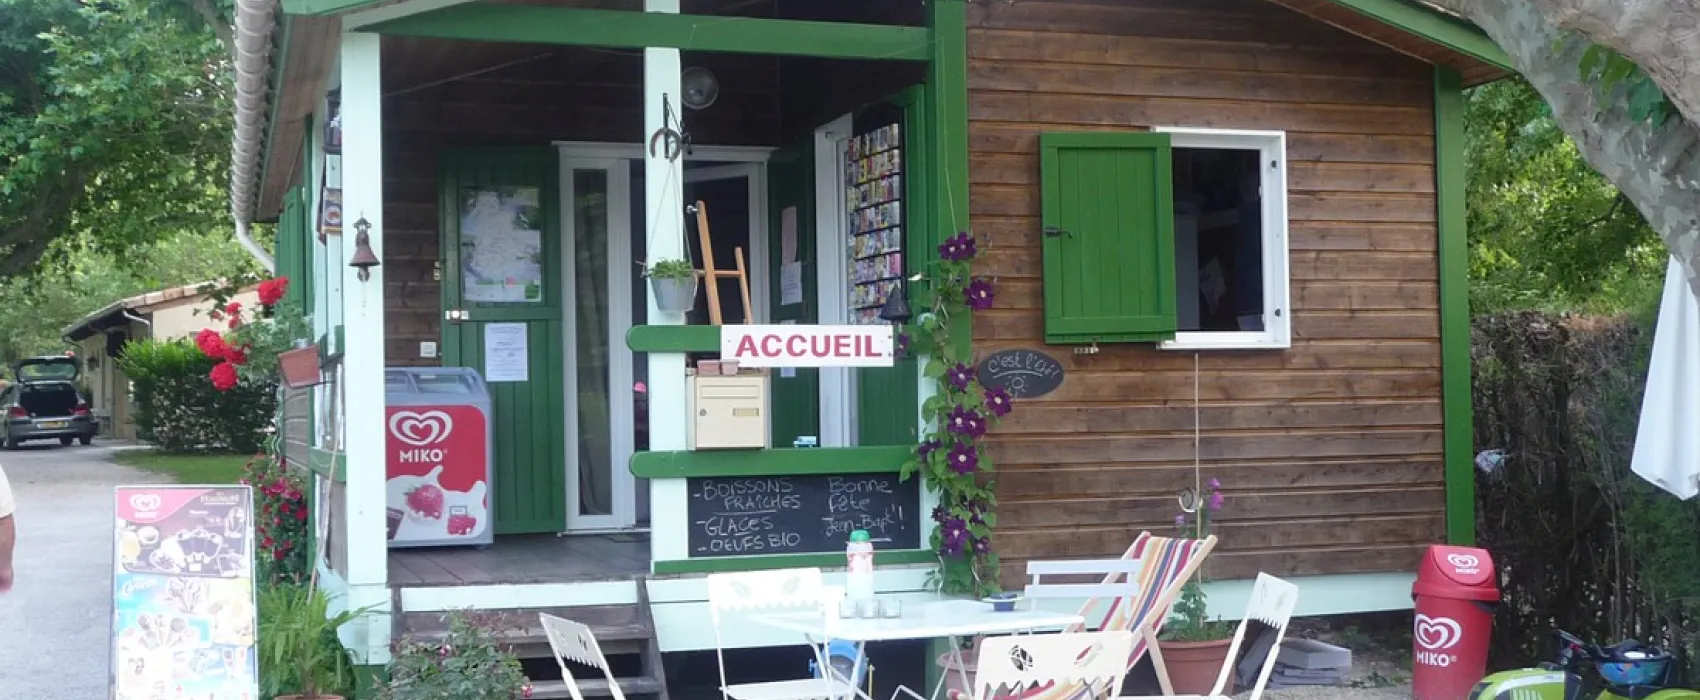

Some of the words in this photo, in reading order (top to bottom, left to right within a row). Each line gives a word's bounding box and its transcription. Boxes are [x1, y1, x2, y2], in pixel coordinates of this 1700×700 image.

[735, 334, 883, 358] ACCUEIL
[399, 448, 443, 463] MIKO
[828, 477, 893, 494] Bonne
[768, 531, 800, 547] BIO
